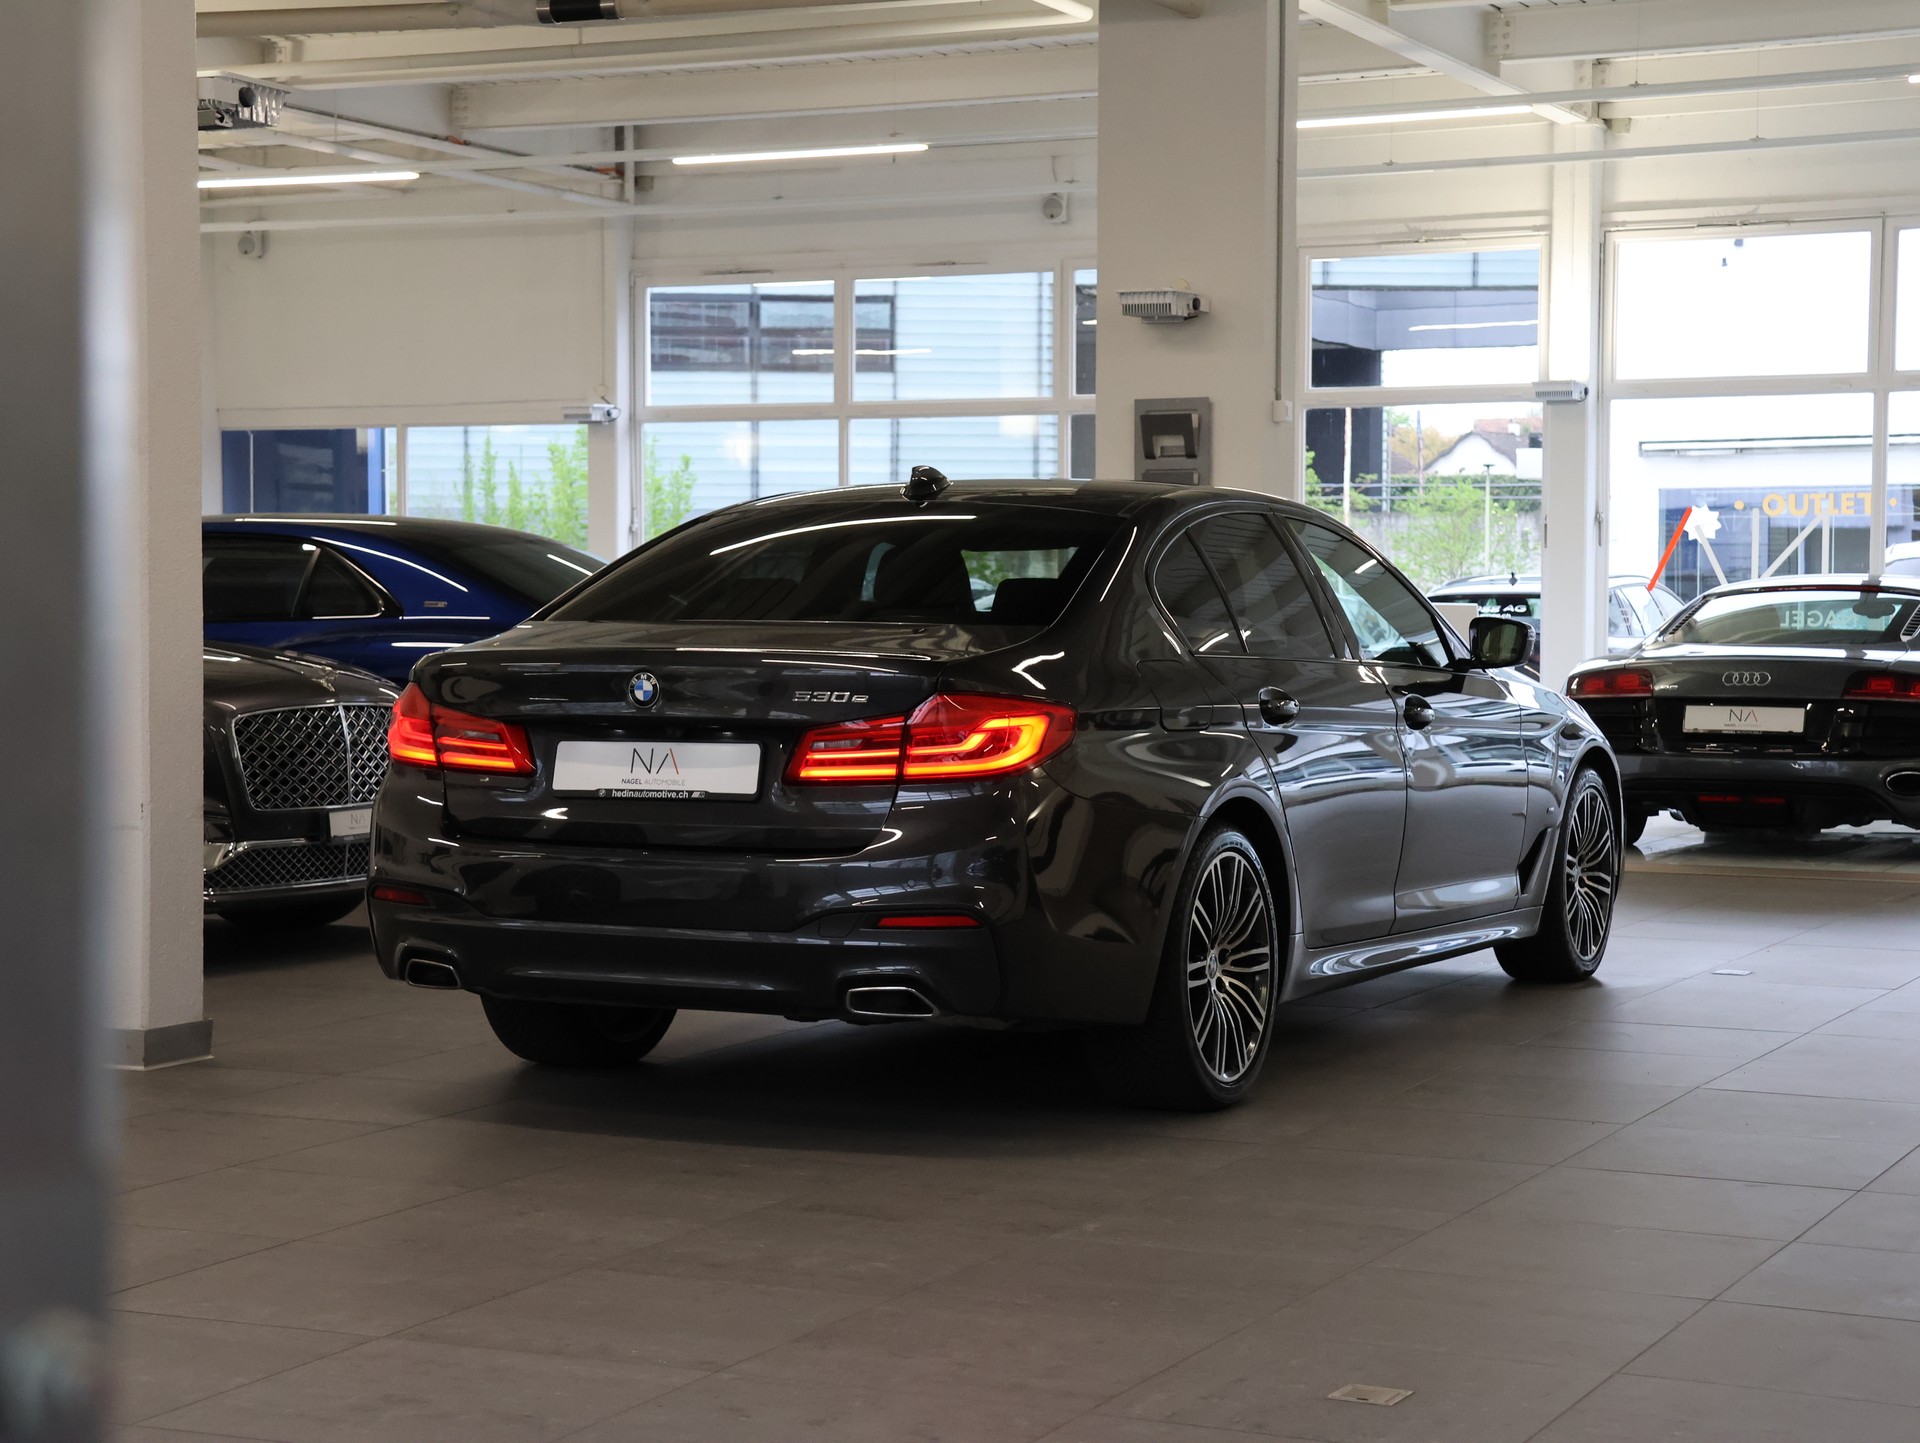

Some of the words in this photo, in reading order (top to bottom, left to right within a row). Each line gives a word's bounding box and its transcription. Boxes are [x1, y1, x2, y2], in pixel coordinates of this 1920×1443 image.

[1762, 492, 1872, 517] OUTLET
[792, 691, 869, 703] 530e
[630, 748, 680, 775] NA
[644, 778, 686, 787] AUTOMOBILE
[611, 789, 689, 799] hedinautomotive.ch
